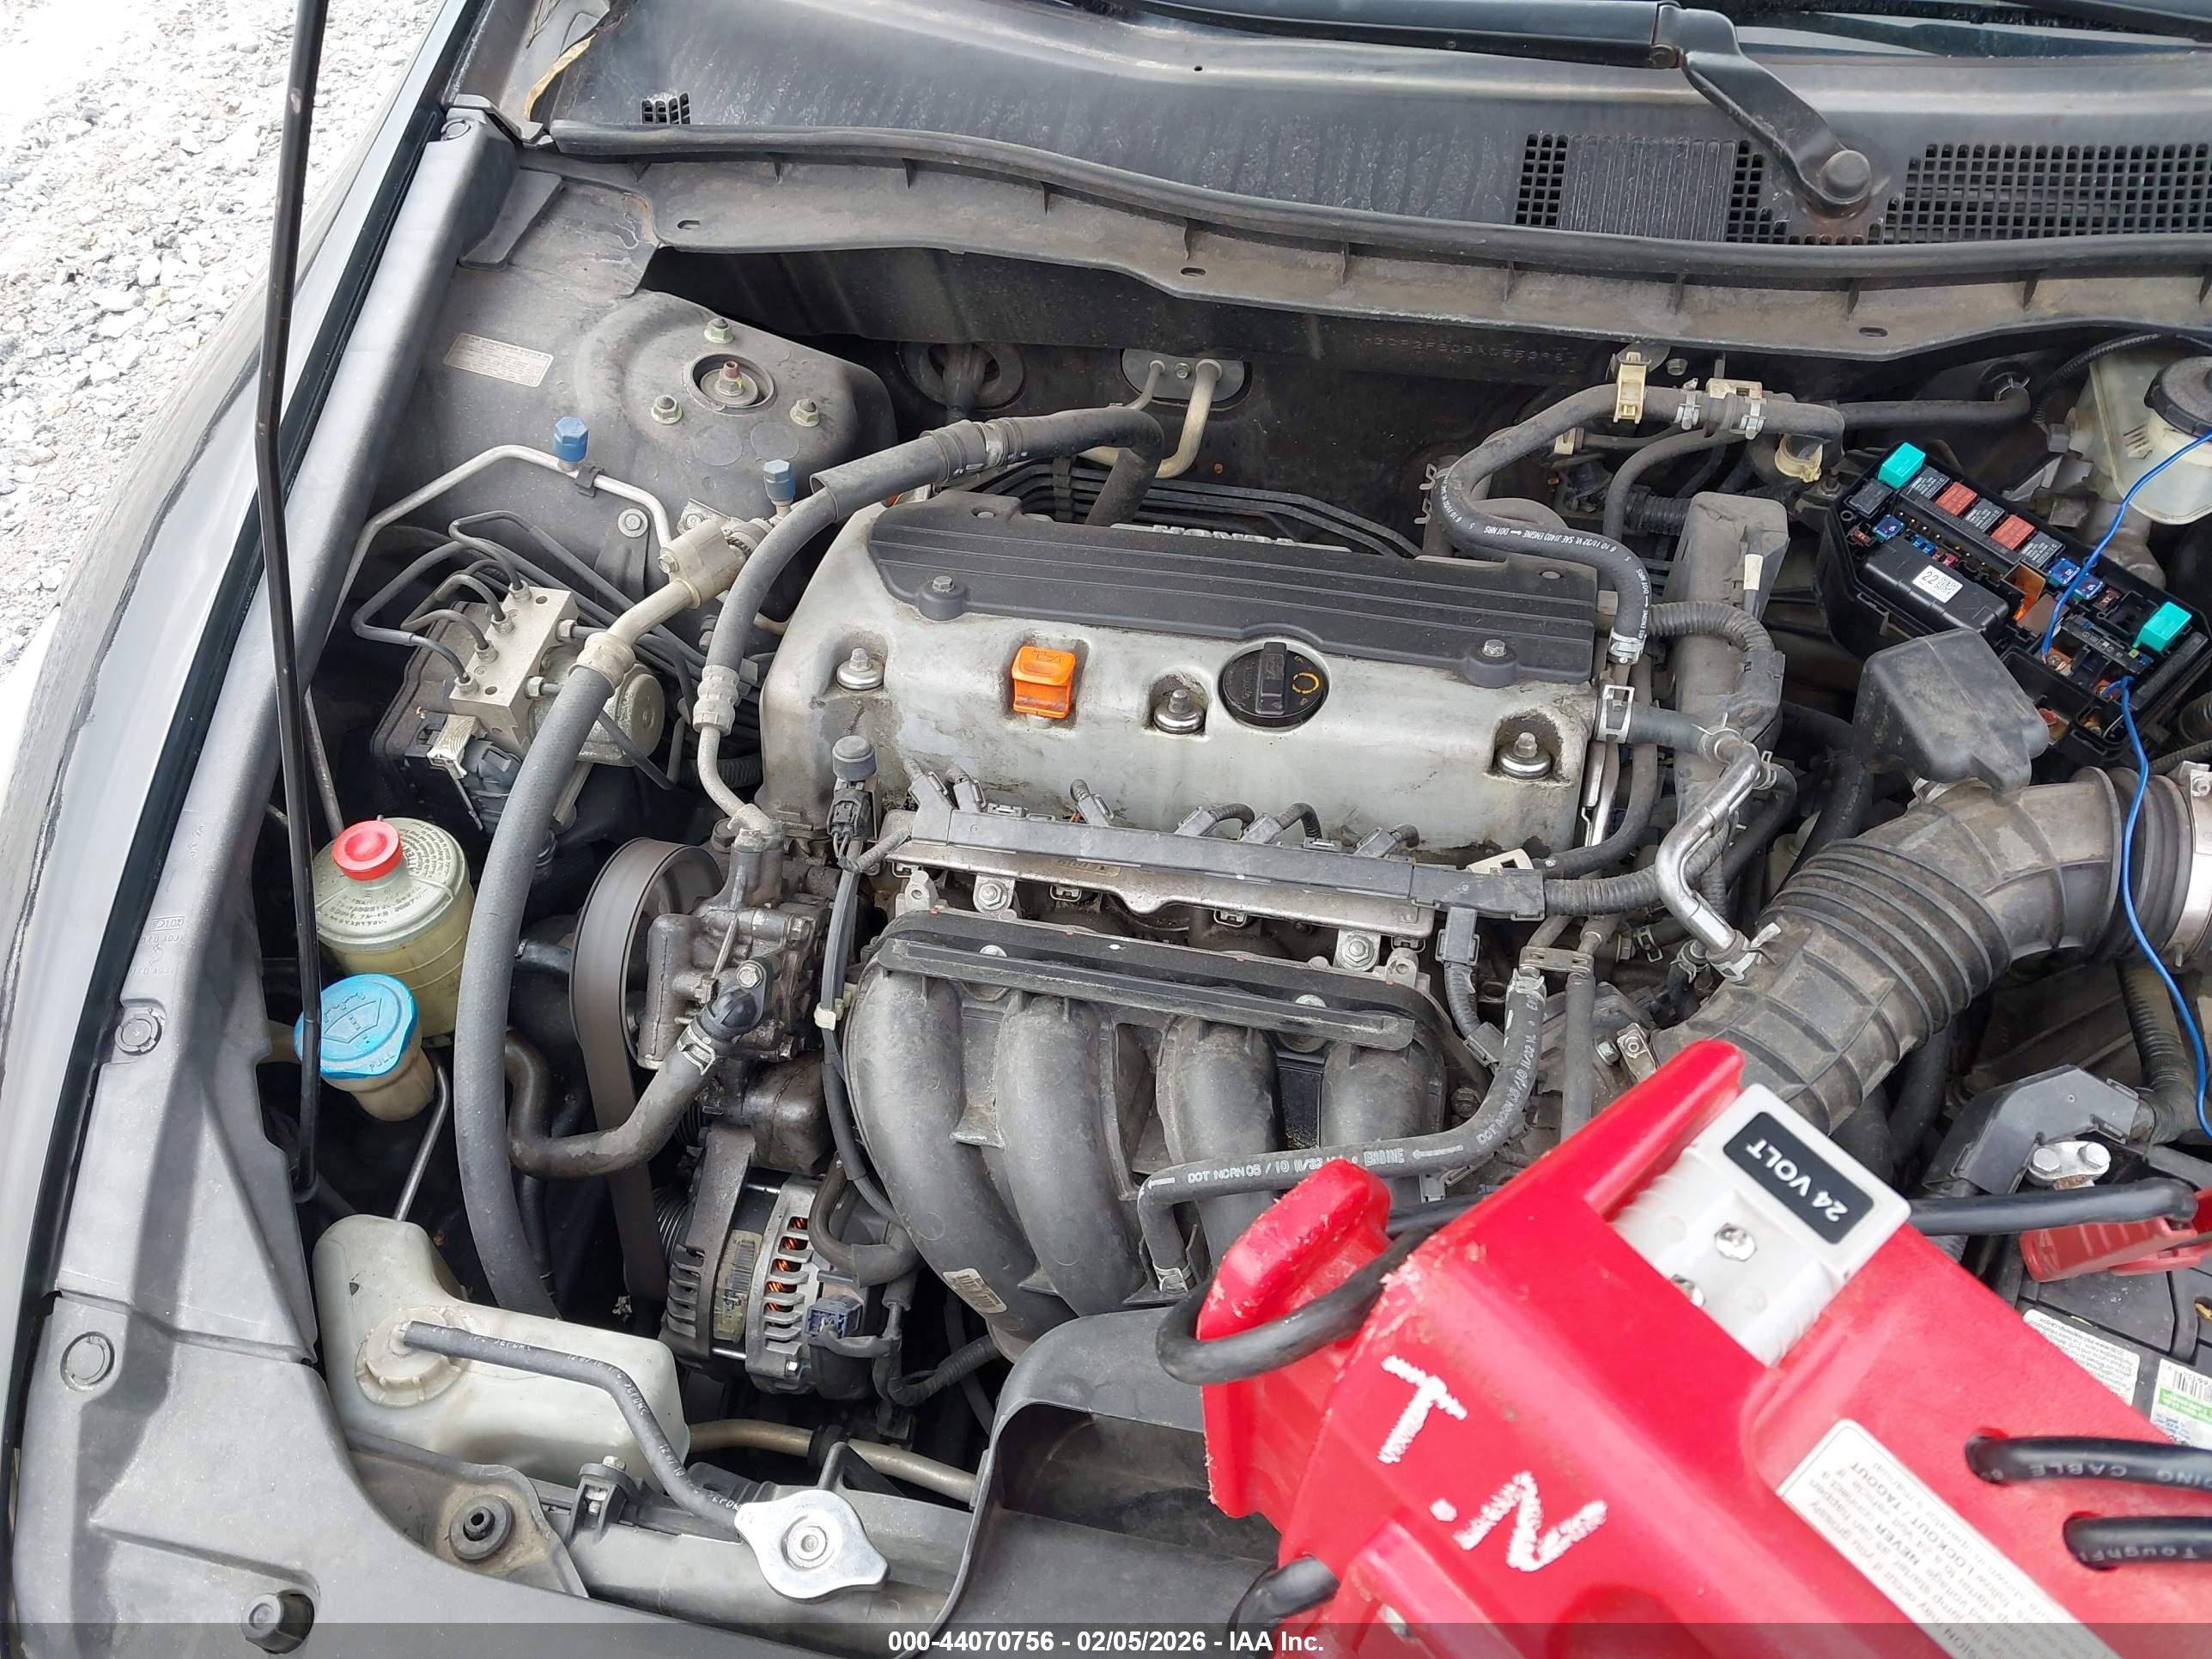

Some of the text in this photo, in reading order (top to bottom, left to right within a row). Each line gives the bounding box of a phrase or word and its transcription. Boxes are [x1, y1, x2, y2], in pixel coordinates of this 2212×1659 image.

[1497, 526, 1510, 535] DOT
[1522, 529, 1544, 539] ENGINE
[1562, 534, 1574, 544] SAE
[1921, 568, 1939, 586] 22
[1639, 609, 1649, 629] ENGINE
[1187, 1170, 1210, 1183] DOT
[1363, 1147, 1406, 1168] ENGINE
[1743, 1131, 1850, 1225] 24 VOLT
[2028, 1460, 2129, 1479] CABLE
[1848, 1458, 1904, 1510] TAGOUT
[1806, 1478, 1853, 1522] happen
[1806, 1497, 1854, 1541] grossly
[1850, 1517, 1875, 1542] can
[1889, 1516, 1917, 1542] Volt
[1850, 1537, 1875, 1562] you
[1873, 1522, 1922, 1567] NEVER
[1874, 1540, 1891, 1556] as
[1909, 1514, 1976, 1576] LOCKOUT
[1941, 1564, 1957, 1579] to
[1881, 1570, 1918, 1604] occur
[1930, 1590, 1965, 1623] jump
